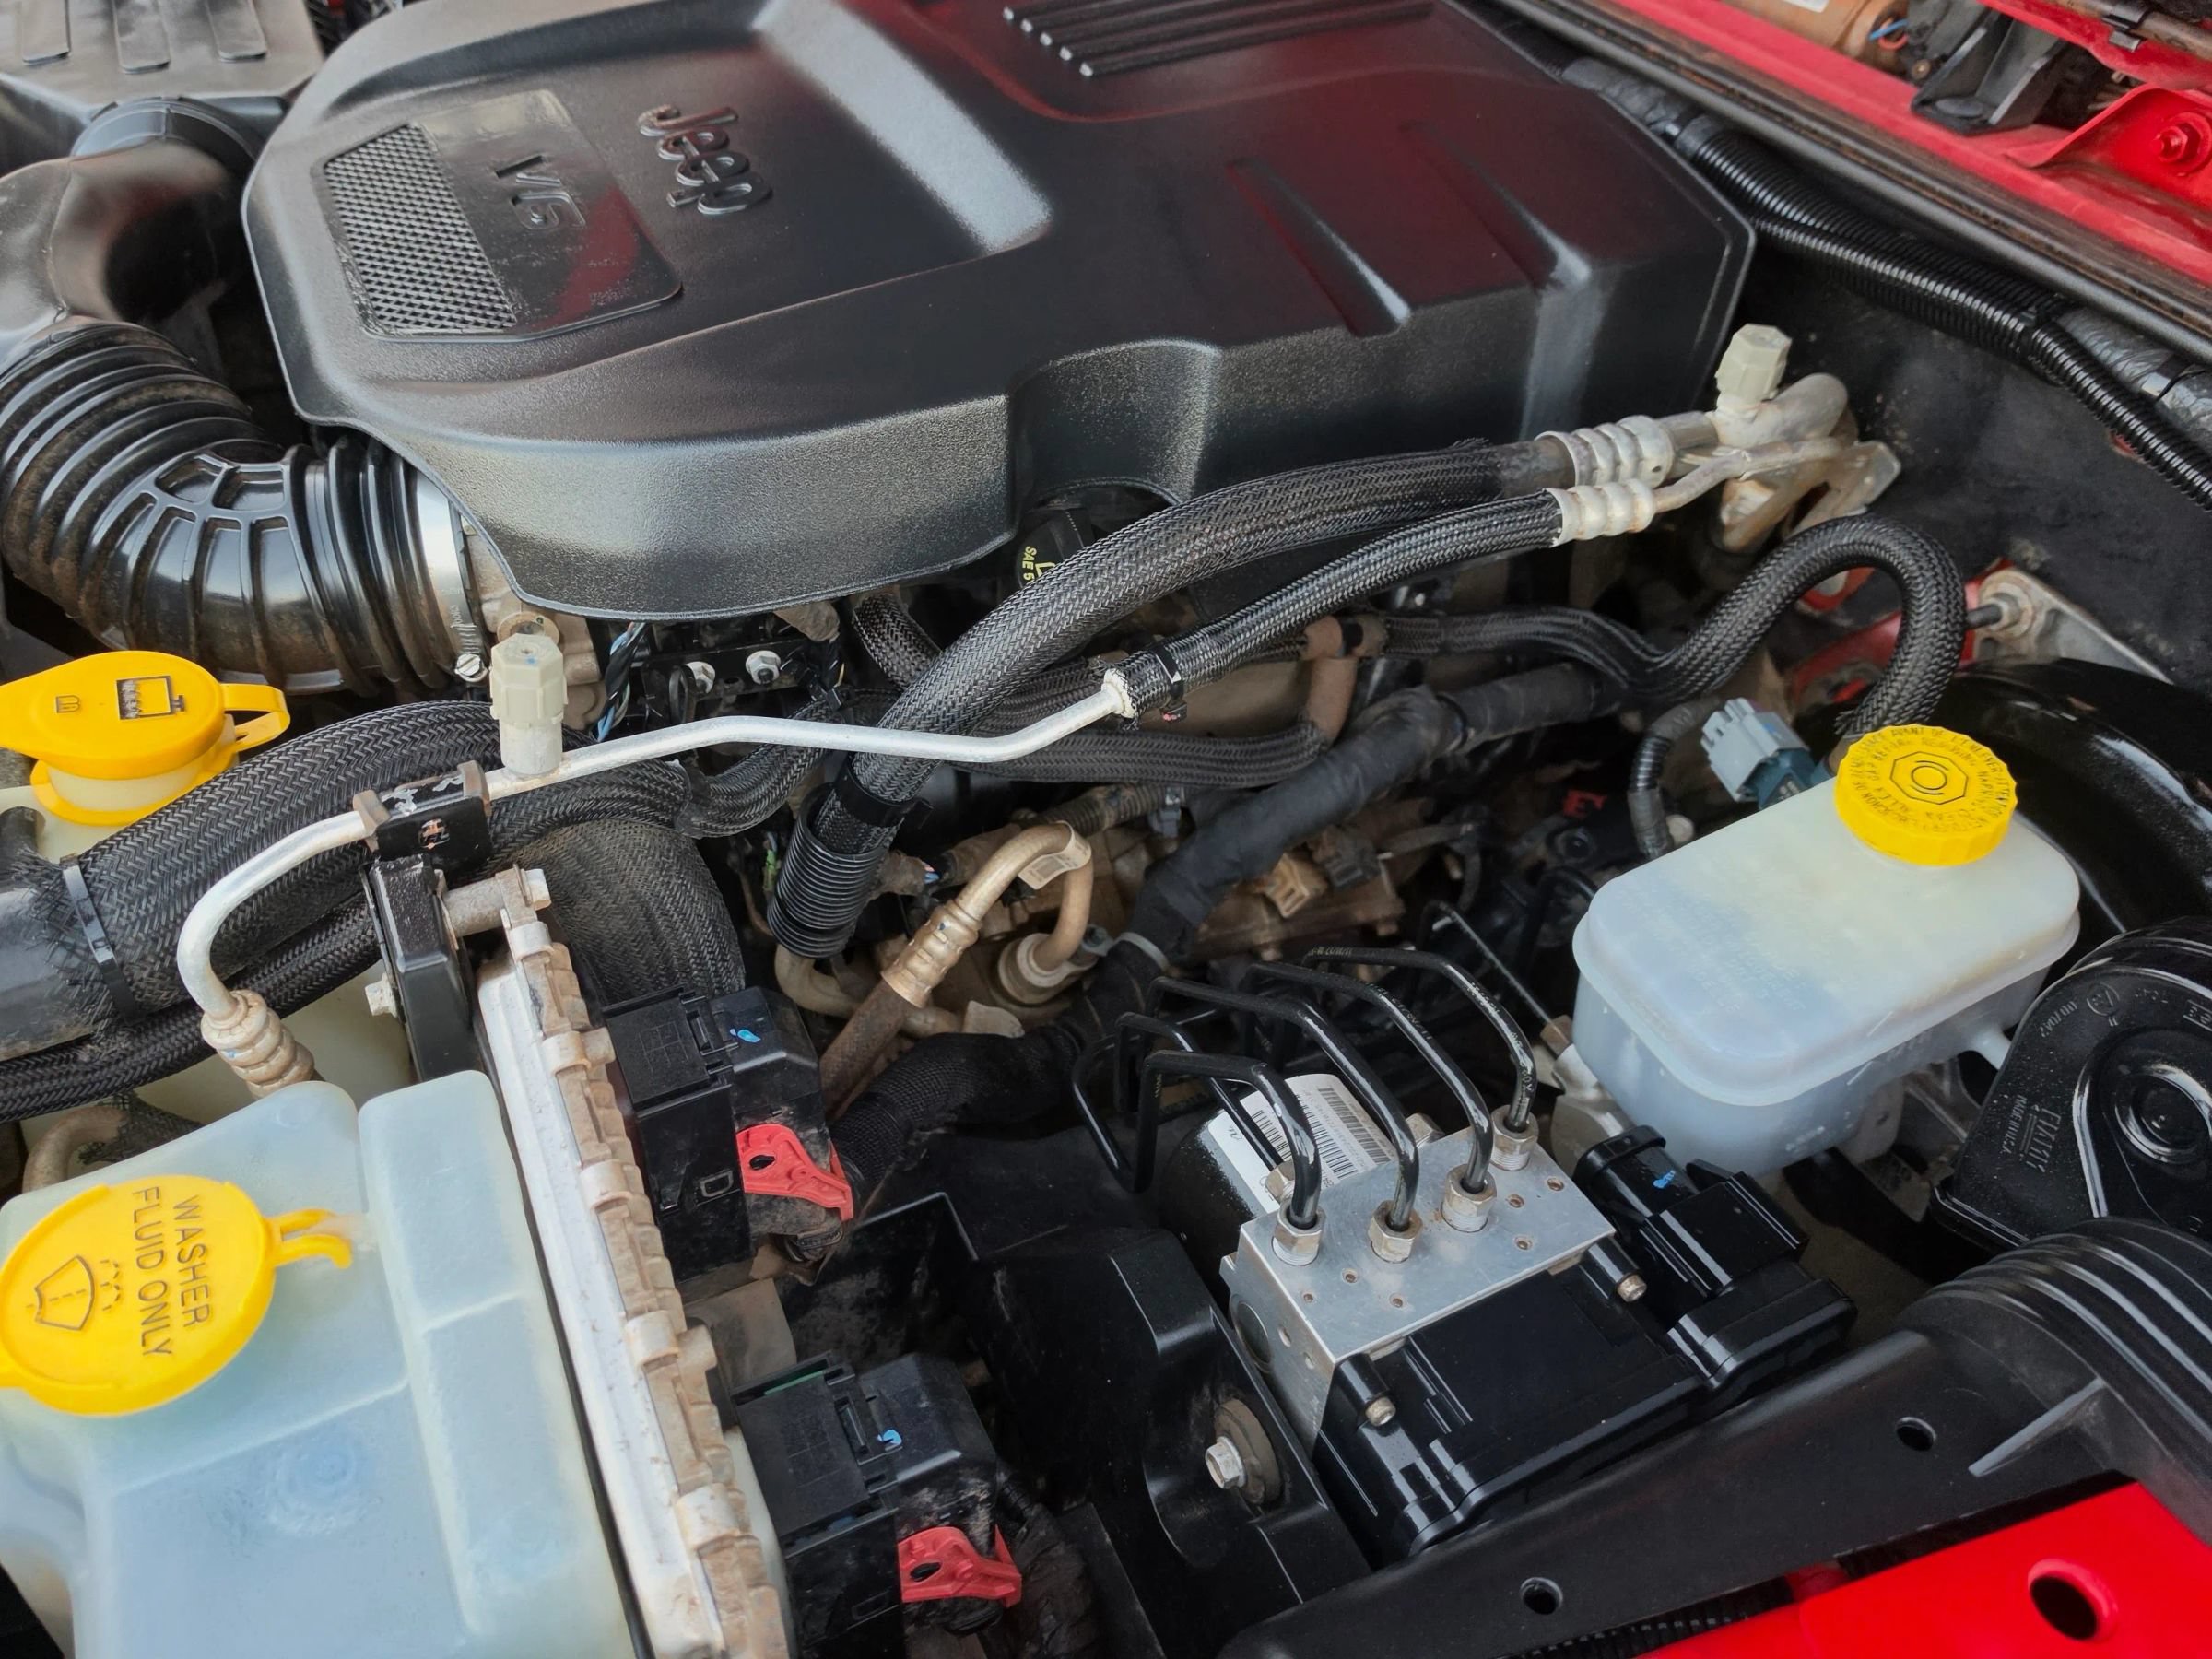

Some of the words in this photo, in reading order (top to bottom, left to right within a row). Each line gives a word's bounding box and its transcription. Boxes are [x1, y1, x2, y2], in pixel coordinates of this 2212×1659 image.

[494, 154, 586, 230] V6
[638, 103, 773, 217] Jeep
[1022, 546, 1037, 570] SAE
[132, 1186, 165, 1270] FLUID
[172, 1194, 211, 1328] WASHER
[137, 1280, 173, 1355] ONLY
